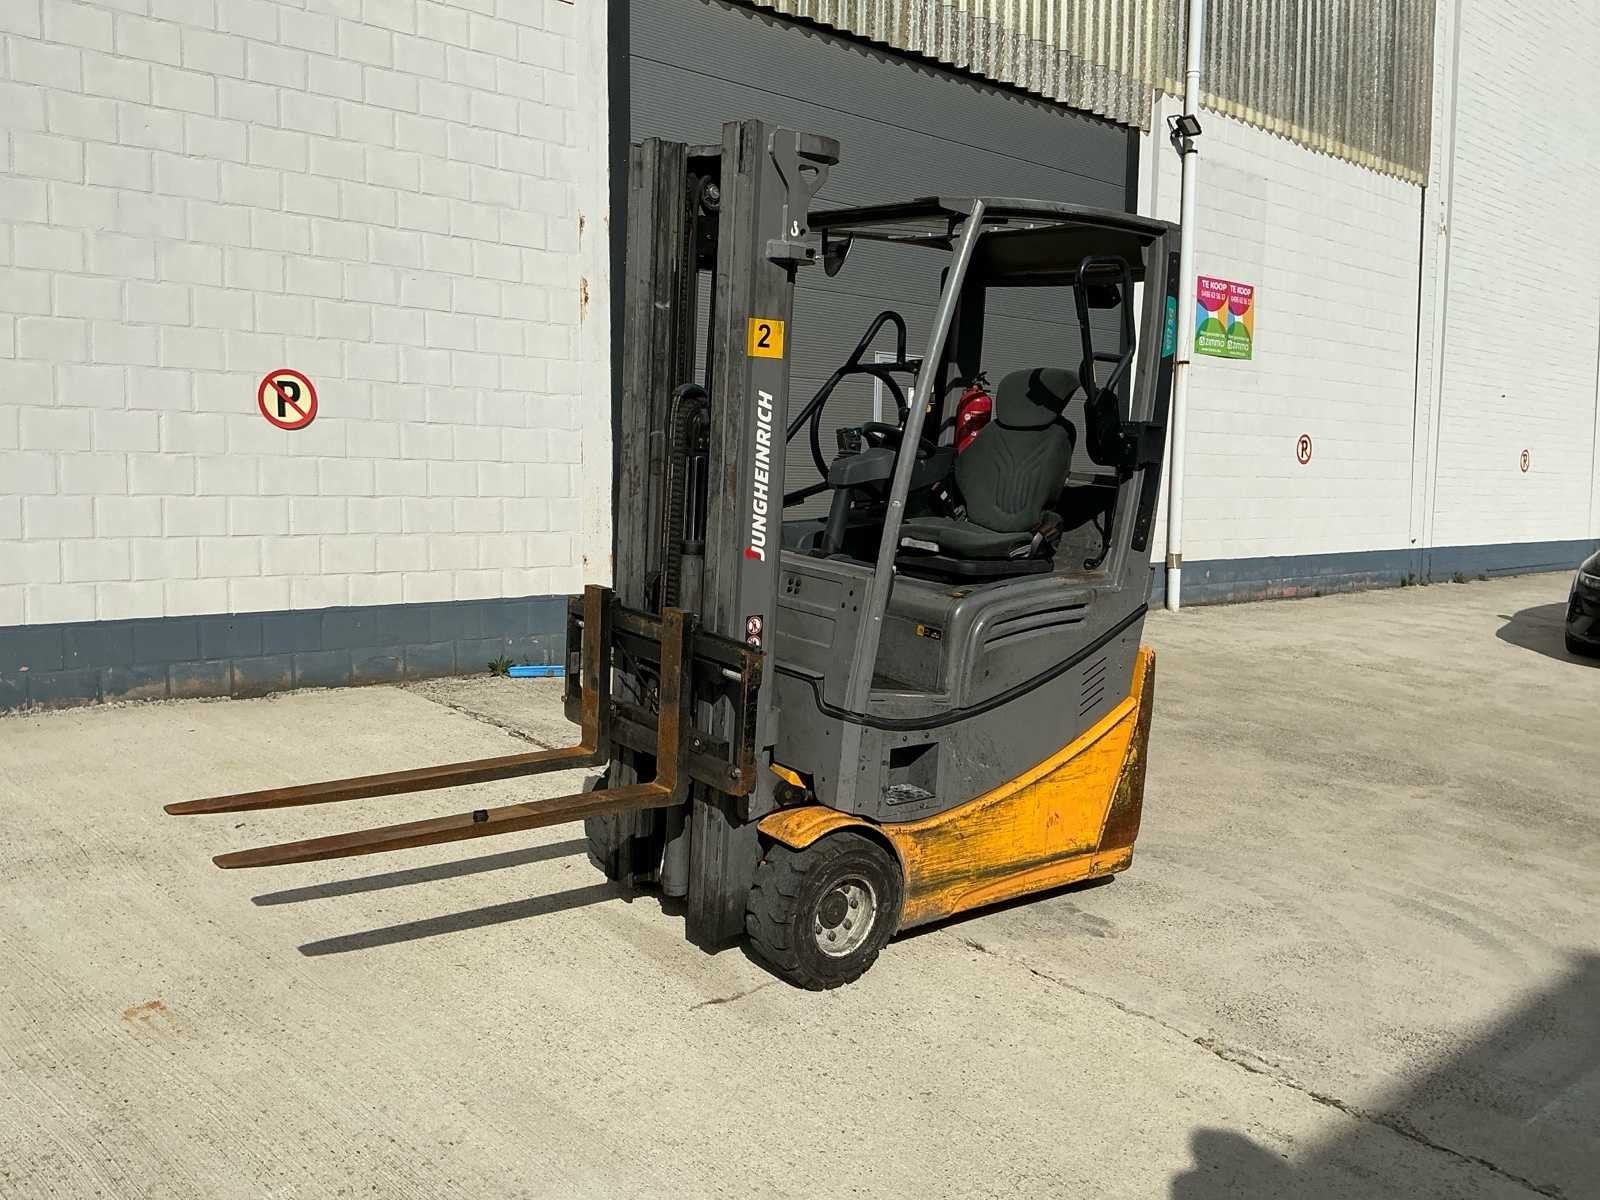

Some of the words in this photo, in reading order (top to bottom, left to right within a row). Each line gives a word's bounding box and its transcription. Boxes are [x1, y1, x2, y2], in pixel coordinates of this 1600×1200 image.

[1202, 280, 1209, 288] TE
[1210, 282, 1228, 291] KOOP
[1237, 287, 1251, 296] KOOP
[758, 324, 771, 348] 2
[276, 380, 301, 417] P
[745, 390, 773, 562] JUNGHEINRICH
